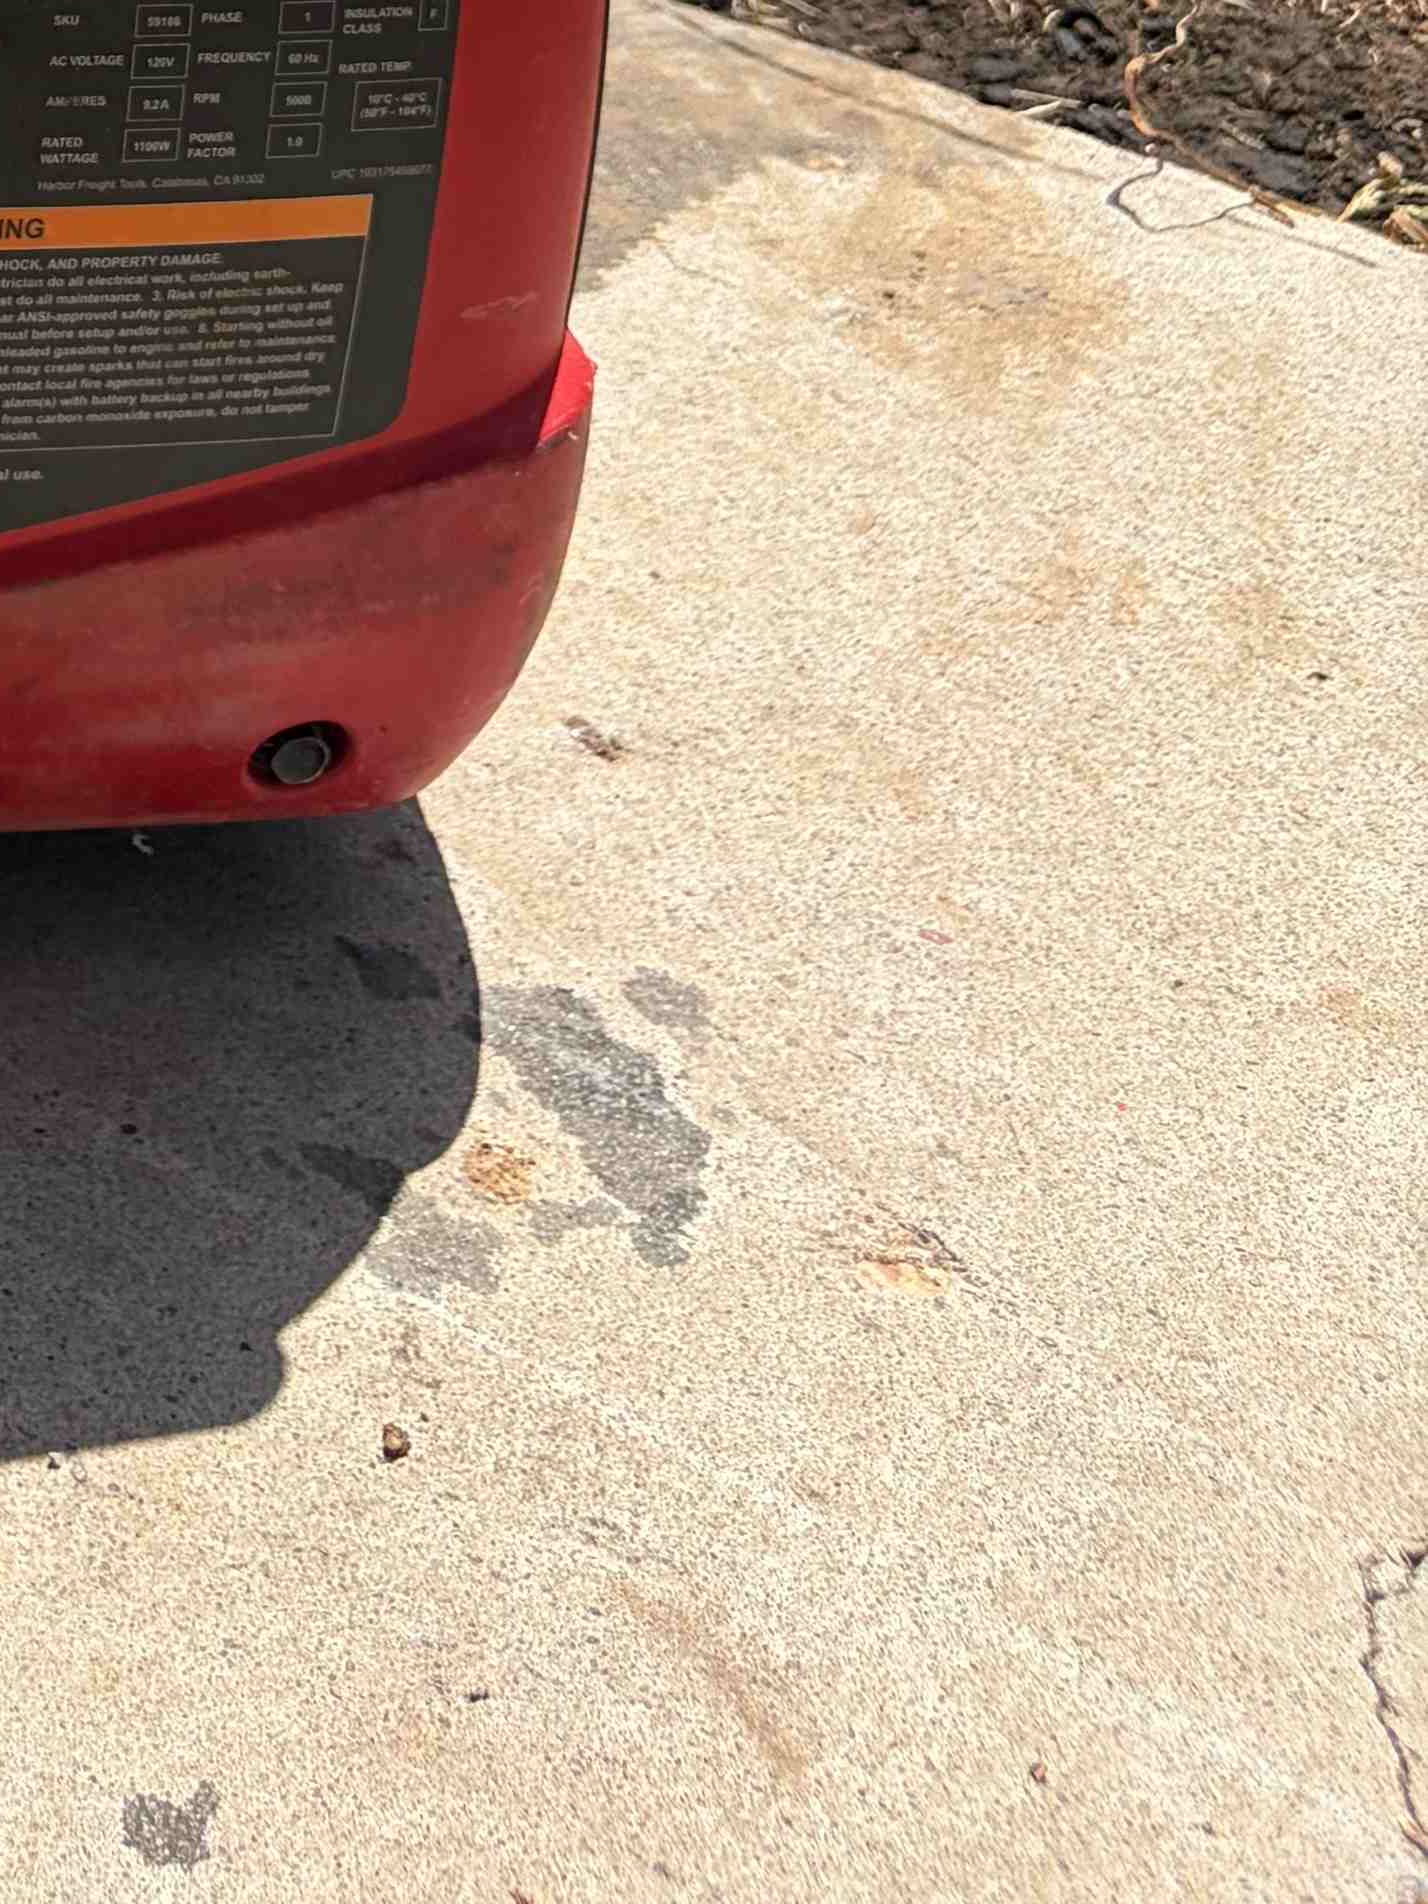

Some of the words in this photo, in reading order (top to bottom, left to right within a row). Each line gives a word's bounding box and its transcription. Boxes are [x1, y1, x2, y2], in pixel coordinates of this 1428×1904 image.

[201, 10, 243, 23] PHASE
[70, 55, 125, 67] VOLTAGE
[197, 50, 272, 65] FREQUENCY
[47, 257, 79, 269] AND
[81, 254, 158, 268] PROPERTY
